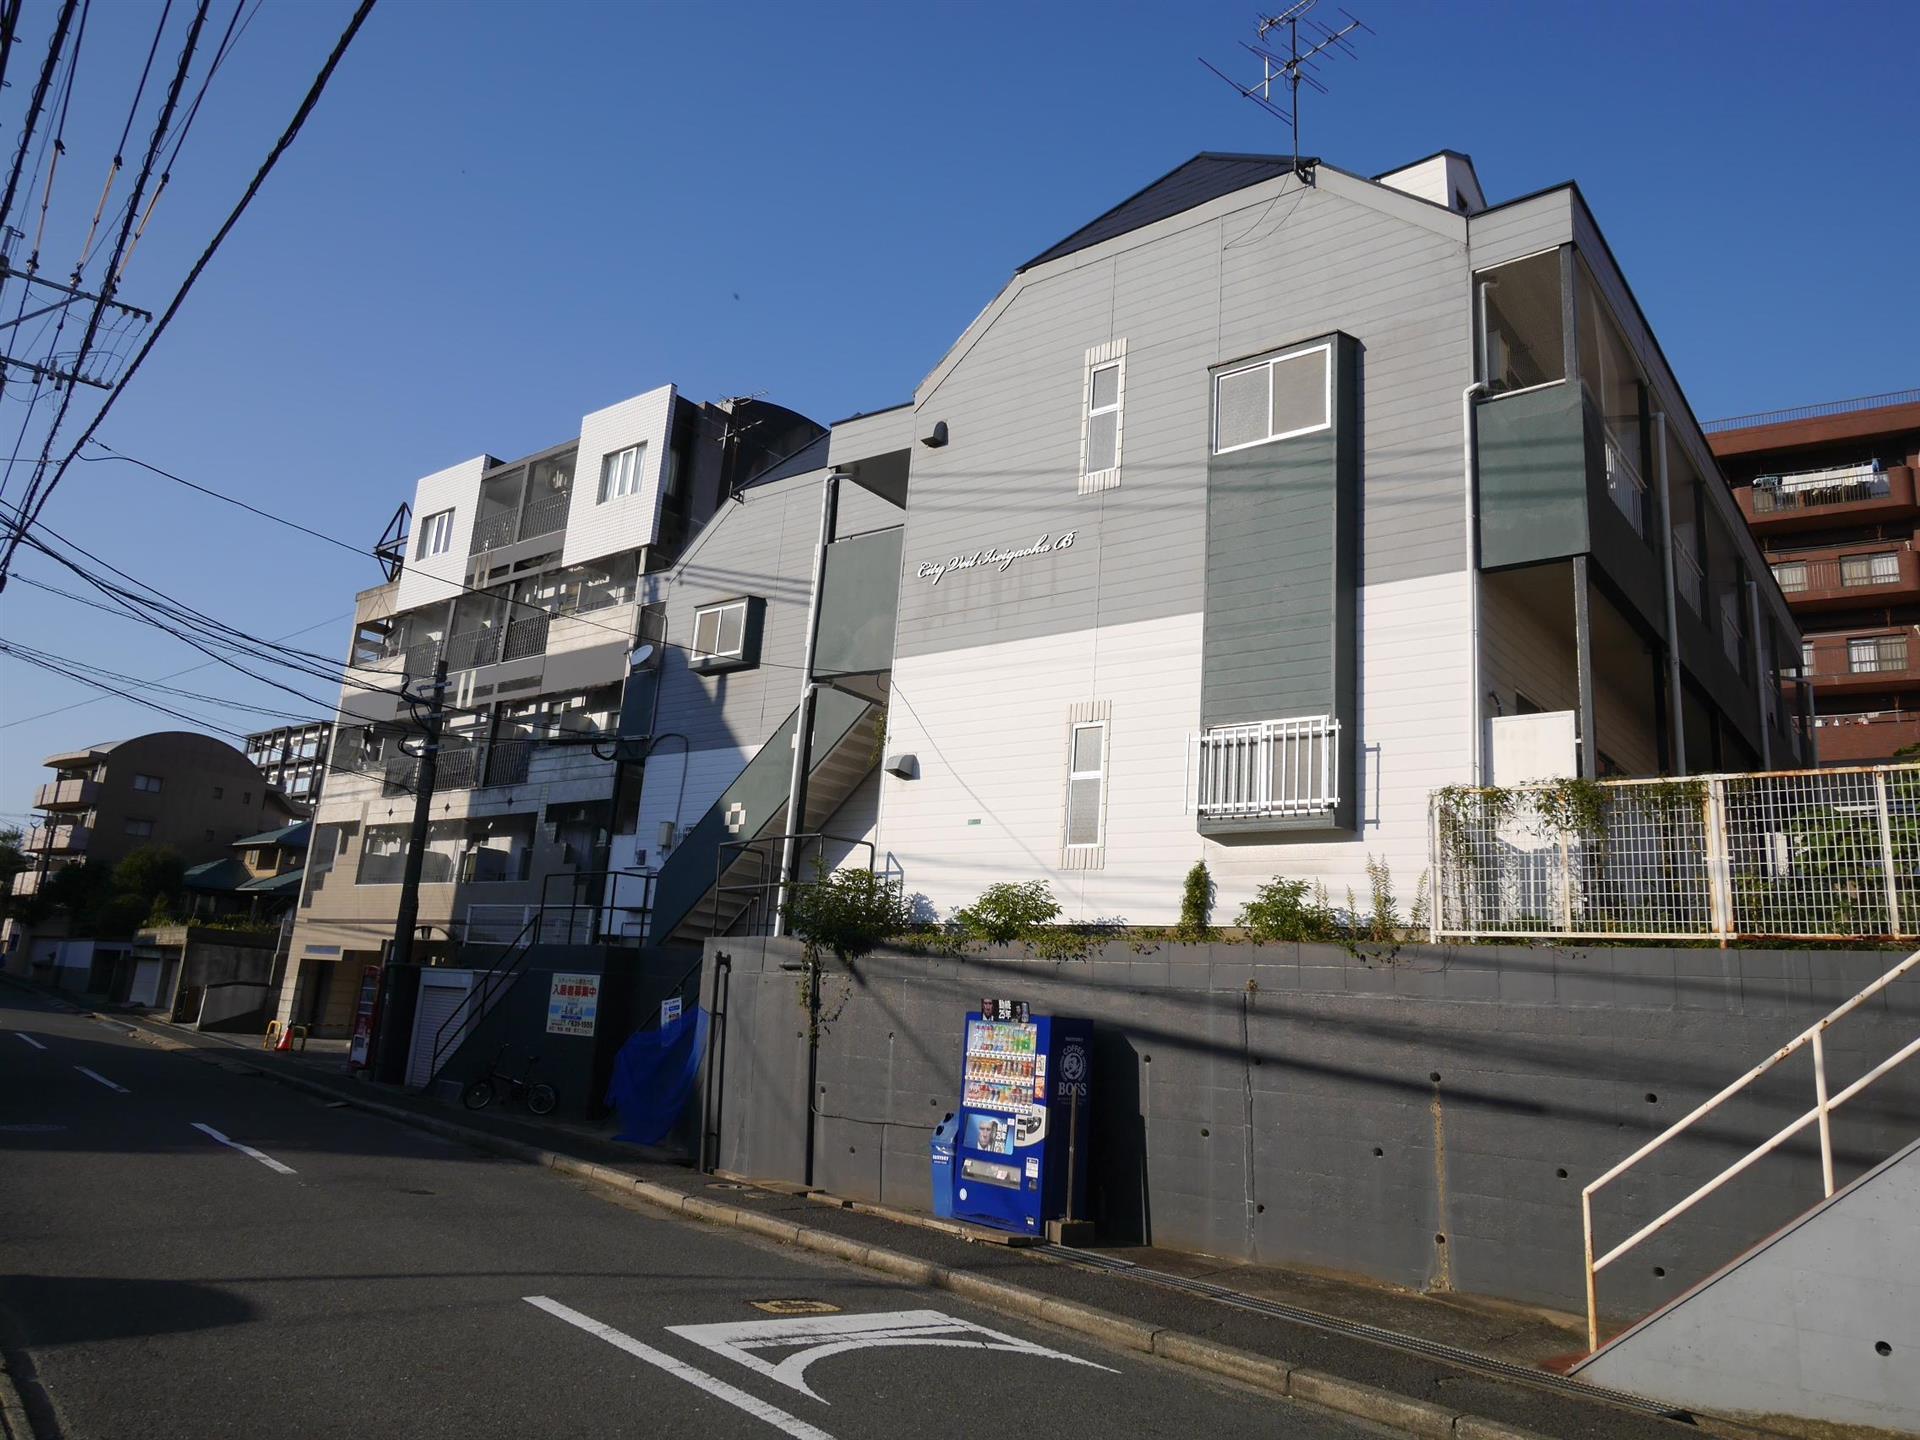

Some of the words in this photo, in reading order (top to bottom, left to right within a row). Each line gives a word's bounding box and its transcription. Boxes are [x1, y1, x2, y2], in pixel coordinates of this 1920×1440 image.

[917, 561, 946, 585] City
[1053, 530, 1077, 550] B
[552, 984, 597, 998] 入居者募集中
[1062, 1044, 1085, 1056] COFFEE
[1058, 1082, 1087, 1096] BOSS
